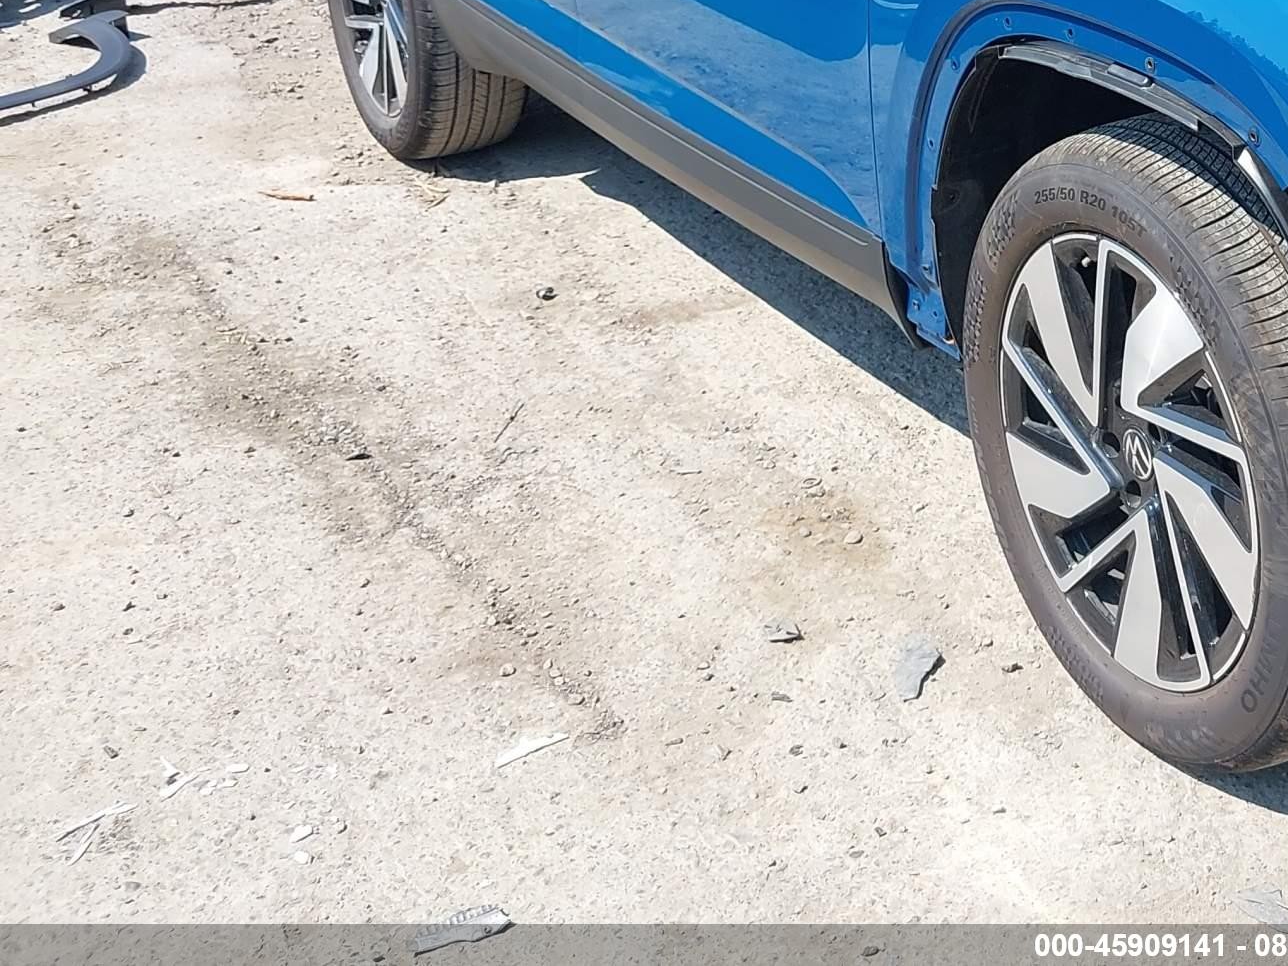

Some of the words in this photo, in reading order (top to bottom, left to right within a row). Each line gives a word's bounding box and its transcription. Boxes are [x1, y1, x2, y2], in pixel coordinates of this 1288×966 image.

[1034, 186, 1076, 205] 255/50
[1079, 189, 1107, 211] R20
[1111, 205, 1149, 237] 105T
